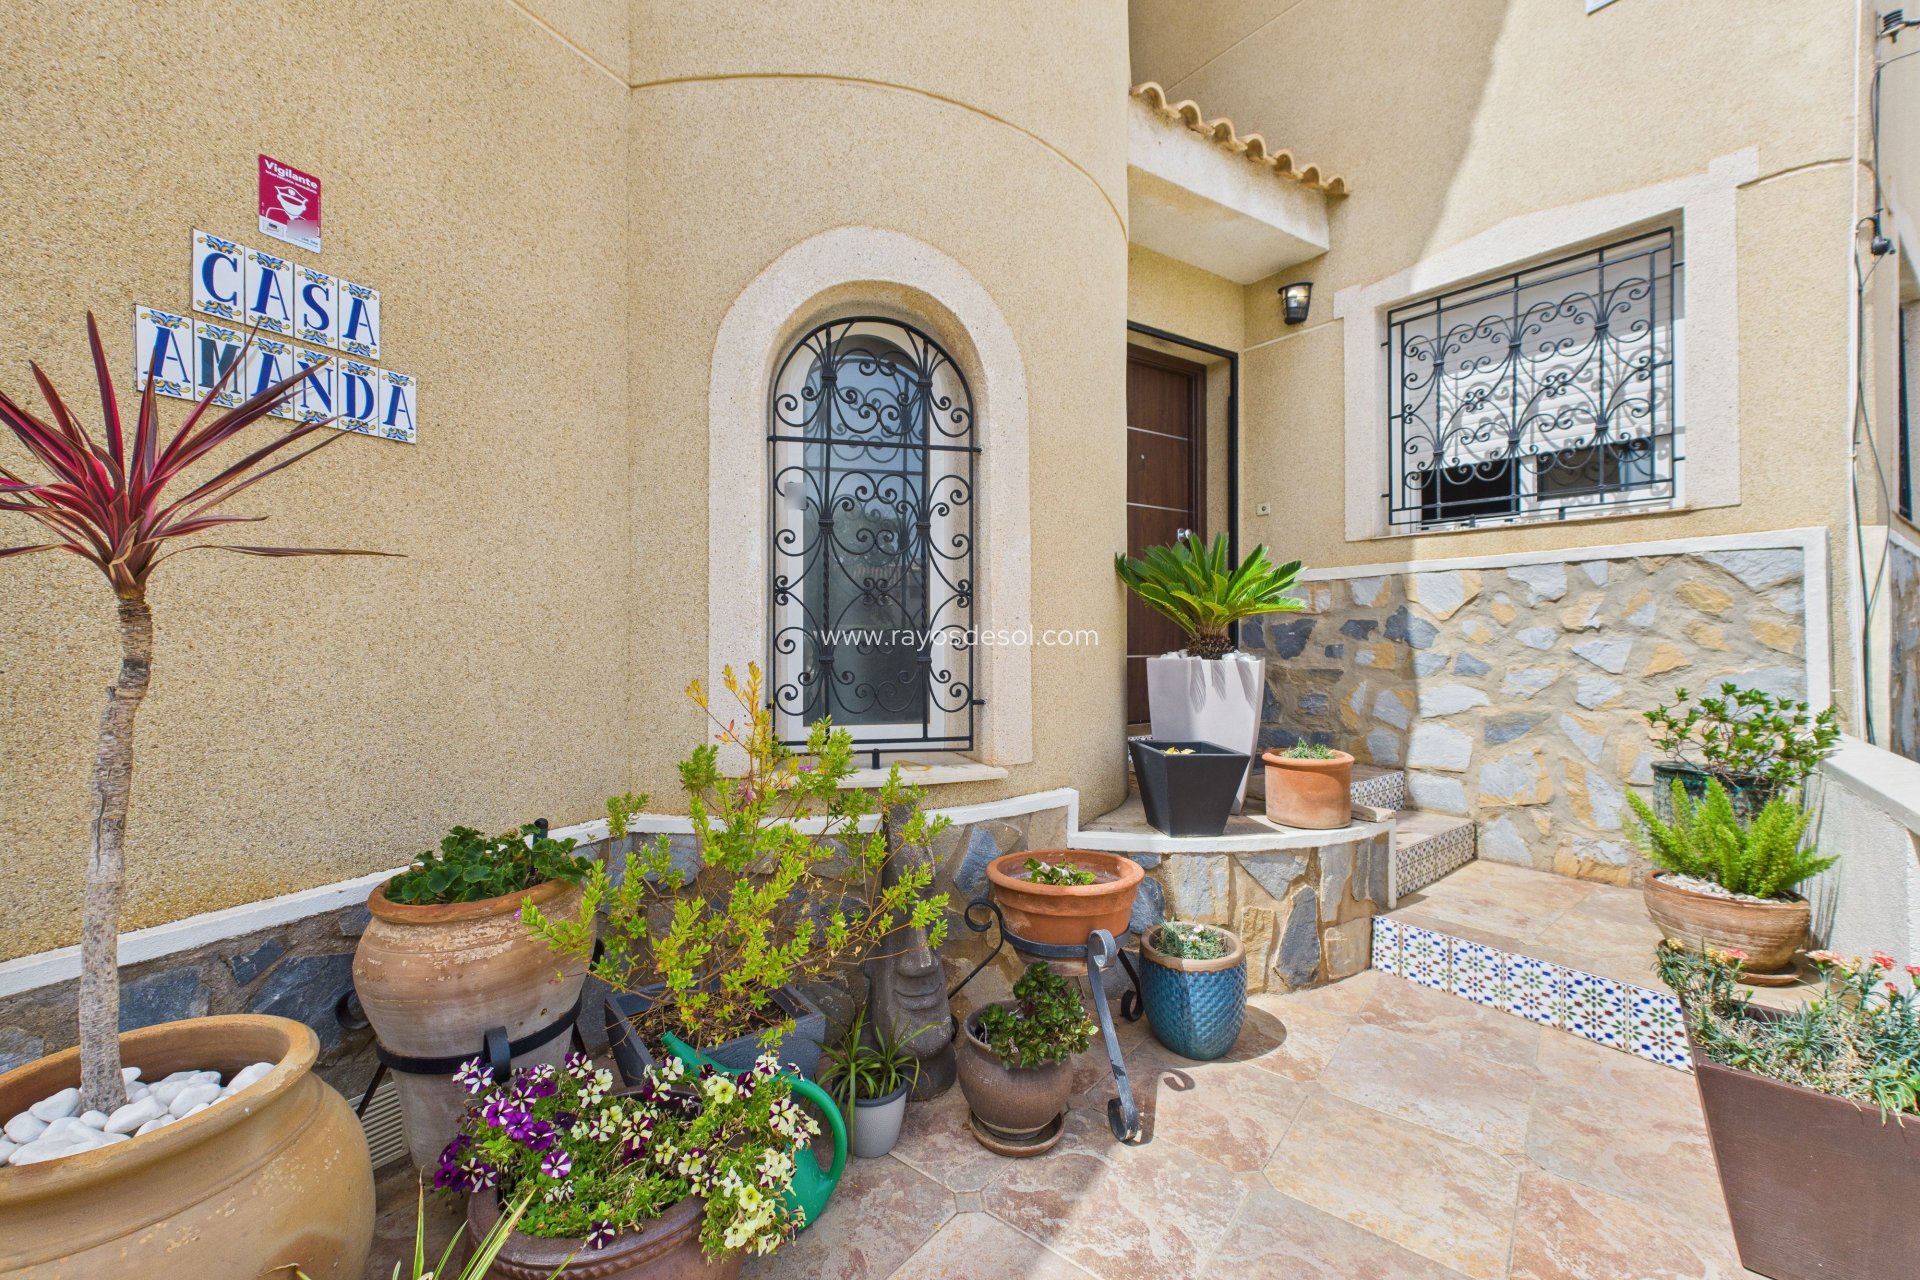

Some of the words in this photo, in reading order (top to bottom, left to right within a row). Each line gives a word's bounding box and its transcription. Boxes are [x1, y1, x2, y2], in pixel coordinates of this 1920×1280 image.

[264, 159, 318, 189] Vigilante
[202, 252, 376, 346] CASA
[143, 326, 414, 430] AMANDA
